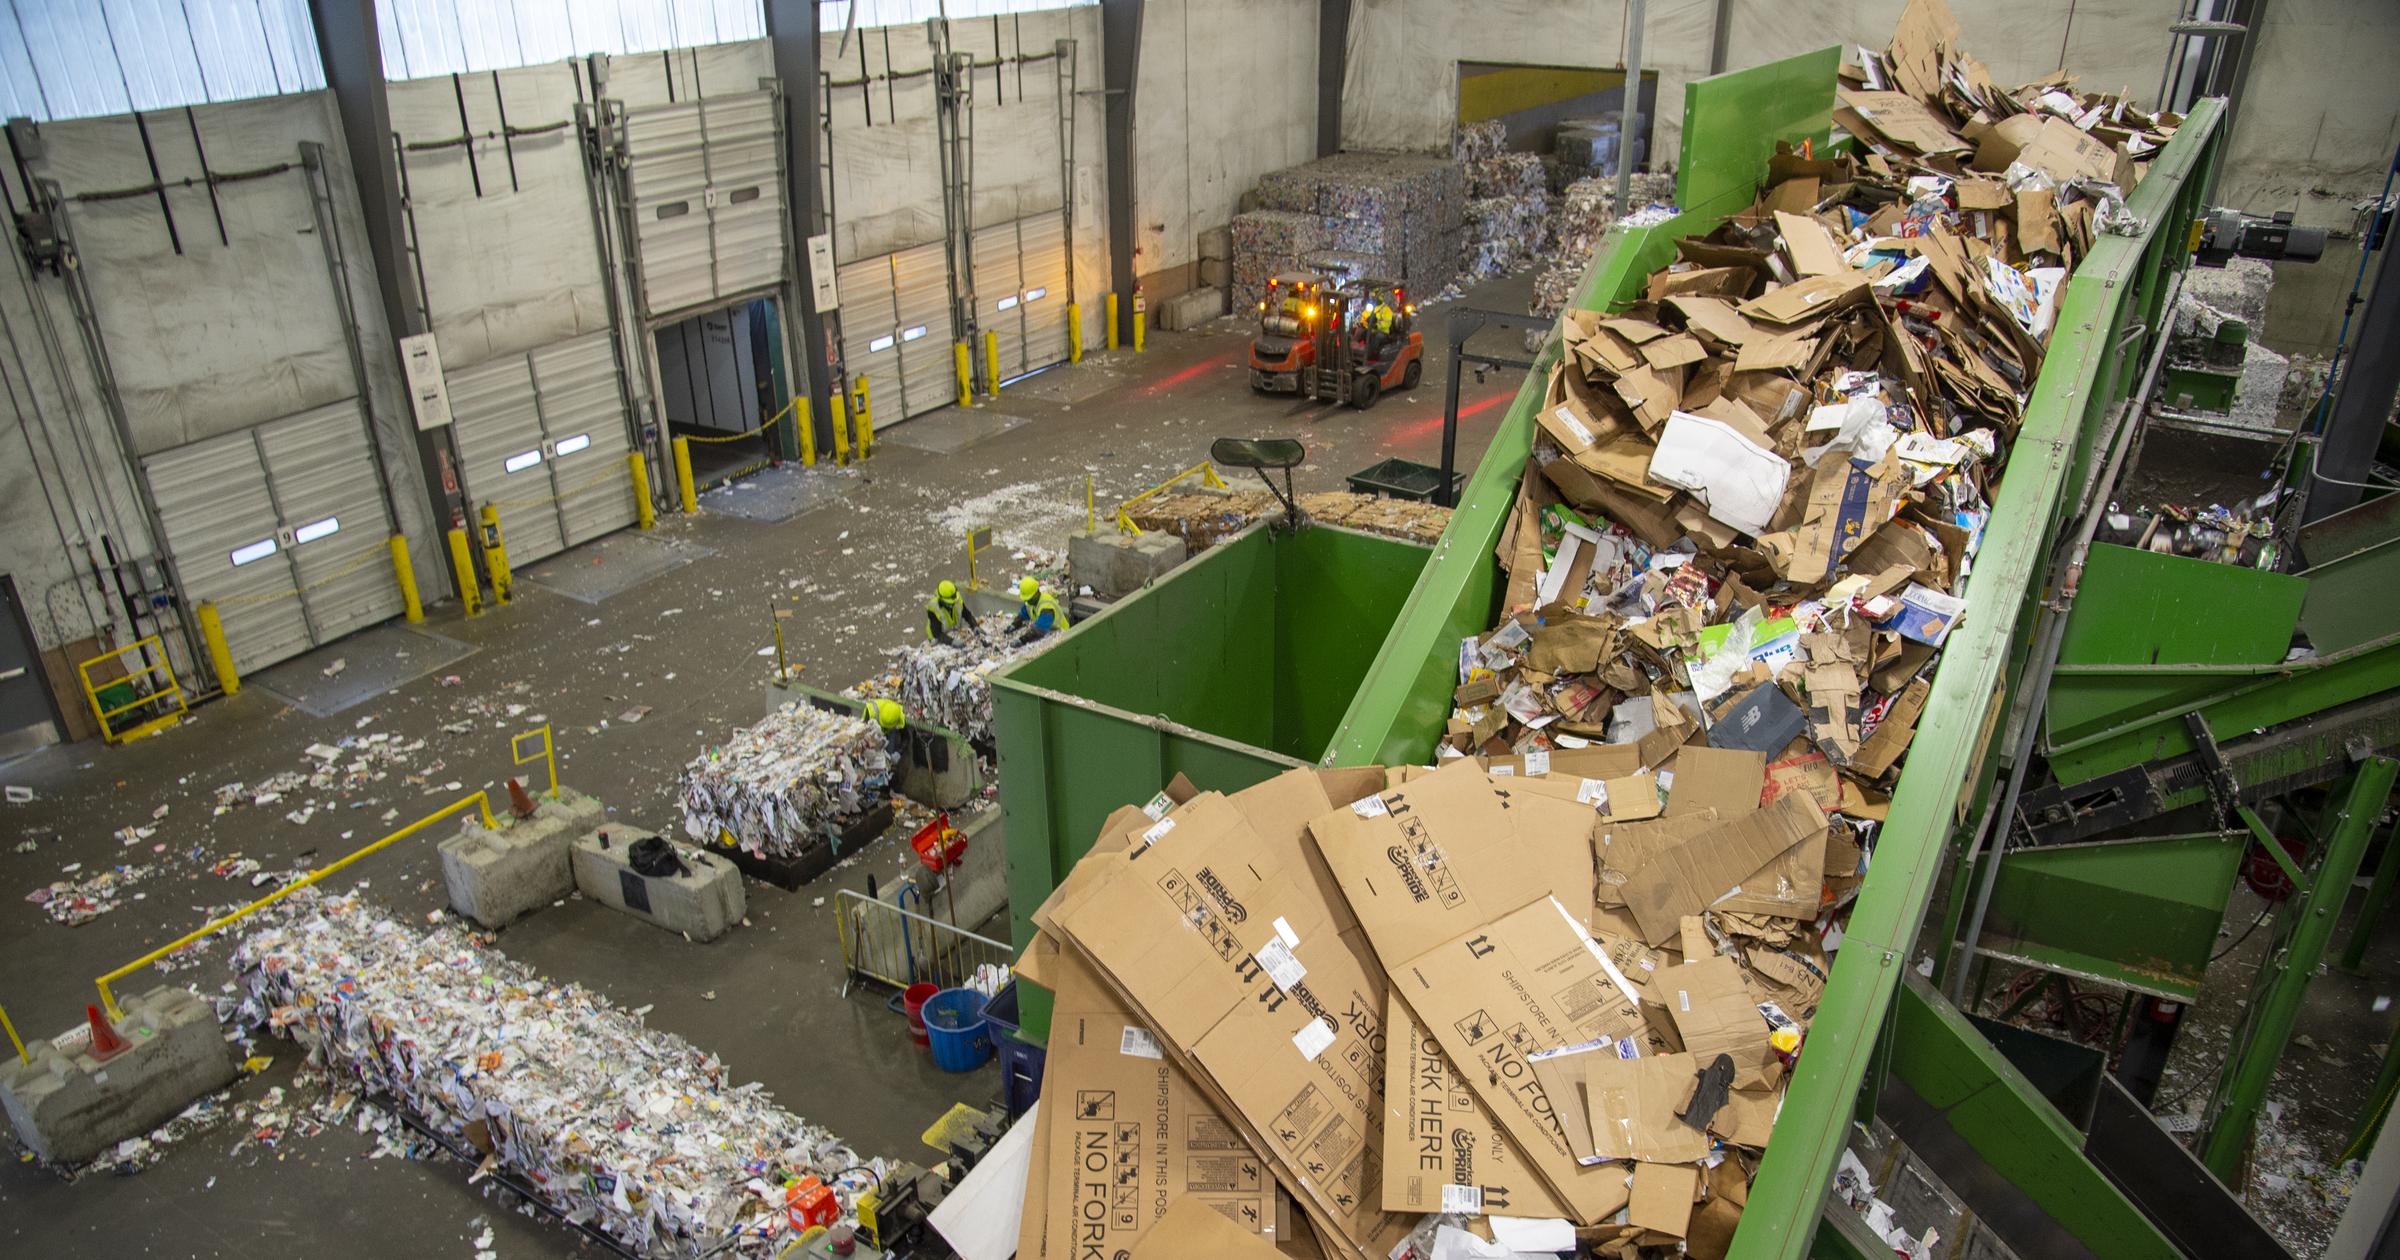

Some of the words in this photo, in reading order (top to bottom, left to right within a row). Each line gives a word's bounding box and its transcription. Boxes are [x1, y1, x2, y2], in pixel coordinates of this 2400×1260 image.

[282, 532, 291, 545] 9
[1156, 797, 1168, 810] 44
[1165, 879, 1178, 891] 9
[1196, 872, 1231, 915] American
[1199, 867, 1236, 906] PRIDE
[1398, 864, 1426, 903] PRIDE
[1401, 855, 1430, 900] American
[1449, 891, 1459, 901] 9
[1501, 970, 1550, 1027] SHIP/STORE
[1548, 1027, 1560, 1041] IN
[1341, 1001, 1386, 1054] ORK
[1349, 1051, 1360, 1063] 9
[1420, 1036, 1442, 1092] ORK
[1487, 1042, 1523, 1079] NO
[1315, 1053, 1356, 1103] POSITION
[1408, 1085, 1416, 1096] AIR
[1157, 1067, 1169, 1140] SHIP/STORE
[1355, 1098, 1376, 1123] THIS
[1458, 1097, 1470, 1106] 9
[1419, 1099, 1442, 1171] HERE
[1500, 1082, 1525, 1112] TERMINAL
[1523, 1108, 1535, 1121] AIR
[1532, 1117, 1567, 1158] CONDITIONER
[1073, 1131, 1082, 1166] PACKAGE
[1085, 1131, 1108, 1173] NO
[1157, 1144, 1168, 1156] IN
[1491, 1134, 1504, 1163] ONLY
[1071, 1169, 1081, 1206] TERMINAL
[1156, 1158, 1168, 1188] THIS
[1071, 1207, 1079, 1219] AIR
[1121, 1214, 1134, 1224] 9
